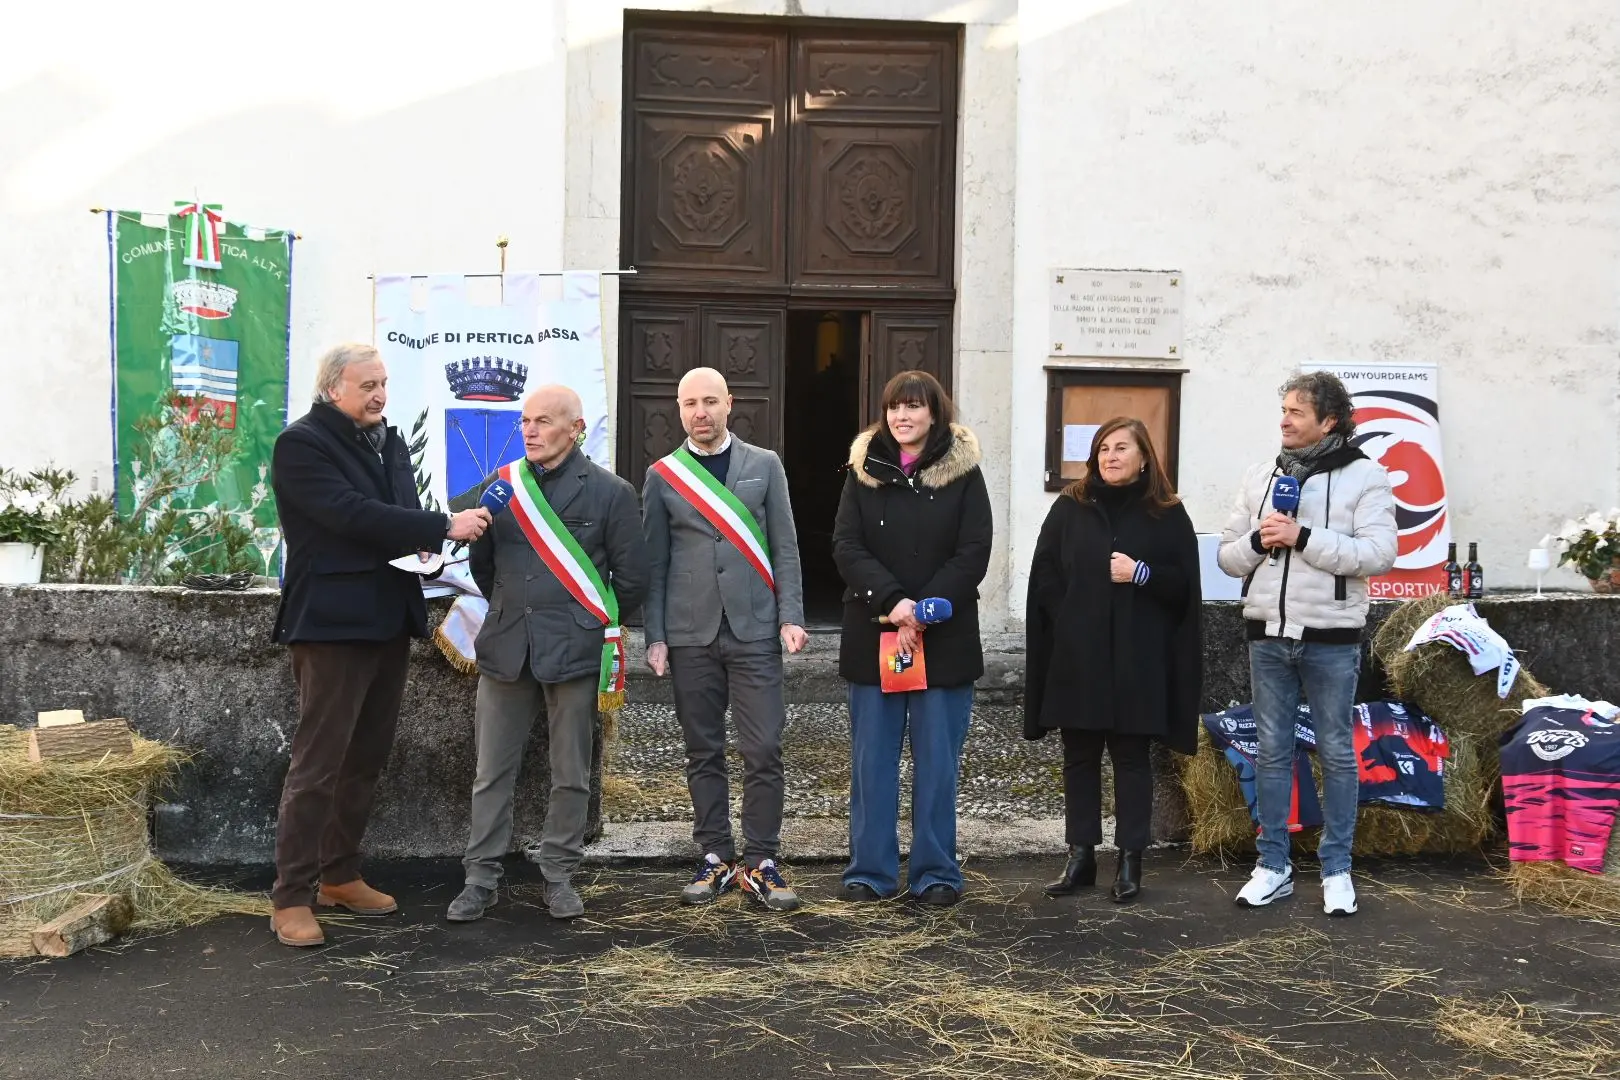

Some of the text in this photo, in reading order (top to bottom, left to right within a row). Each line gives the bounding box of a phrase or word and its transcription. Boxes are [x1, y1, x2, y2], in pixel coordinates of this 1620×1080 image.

[121, 239, 176, 264] COMUNE
[220, 243, 248, 260] TICA
[251, 255, 283, 281] ALTA
[387, 327, 580, 350] COMUNE DI PERTICA BASSA
[1337, 371, 1429, 381] LOWYOURDREAMS
[1368, 582, 1441, 596] SPORTIV
